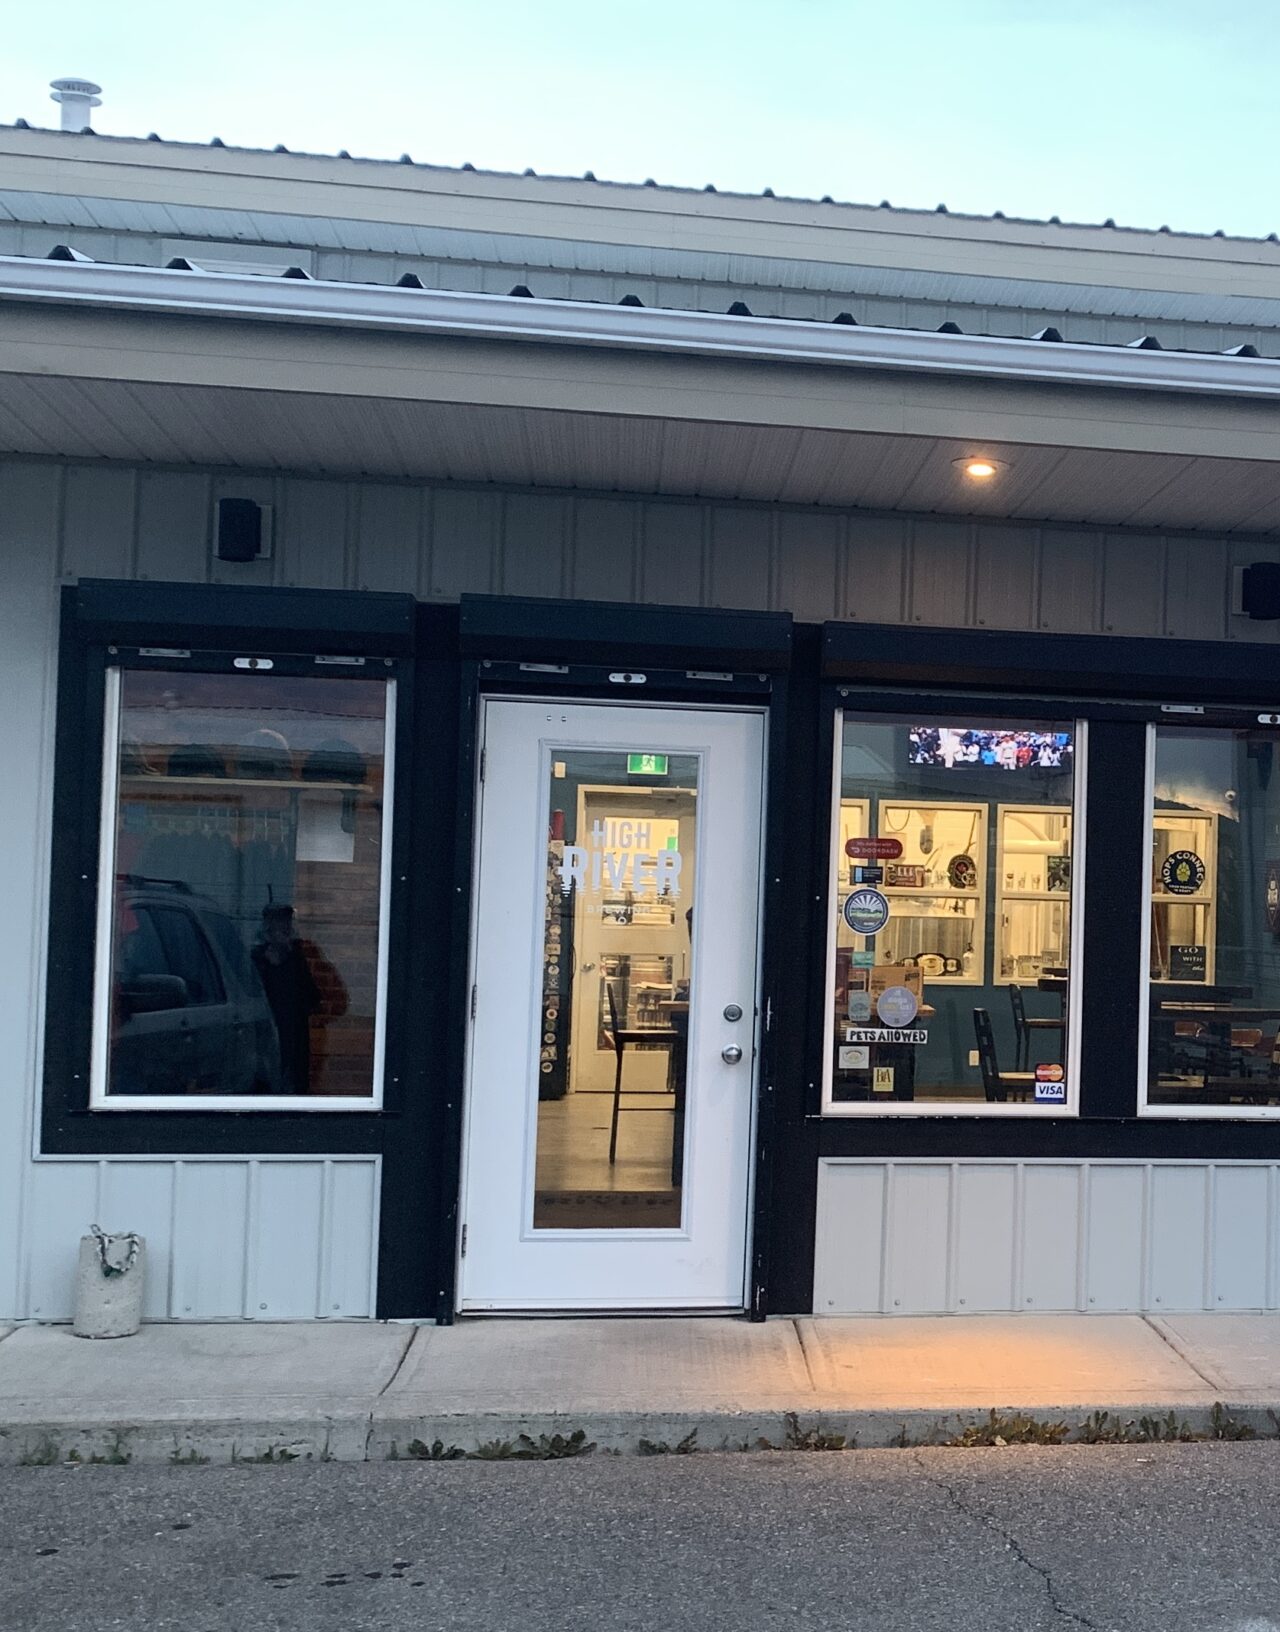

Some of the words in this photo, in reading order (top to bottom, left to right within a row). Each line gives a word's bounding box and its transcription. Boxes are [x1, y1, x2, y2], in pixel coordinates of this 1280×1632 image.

[591, 818, 652, 849] HIGH
[558, 845, 683, 894] RIVER
[1163, 856, 1176, 884] HOPS
[1176, 852, 1204, 886] CONNECT
[849, 1030, 876, 1041] PETS
[1039, 1085, 1063, 1095] VISA
